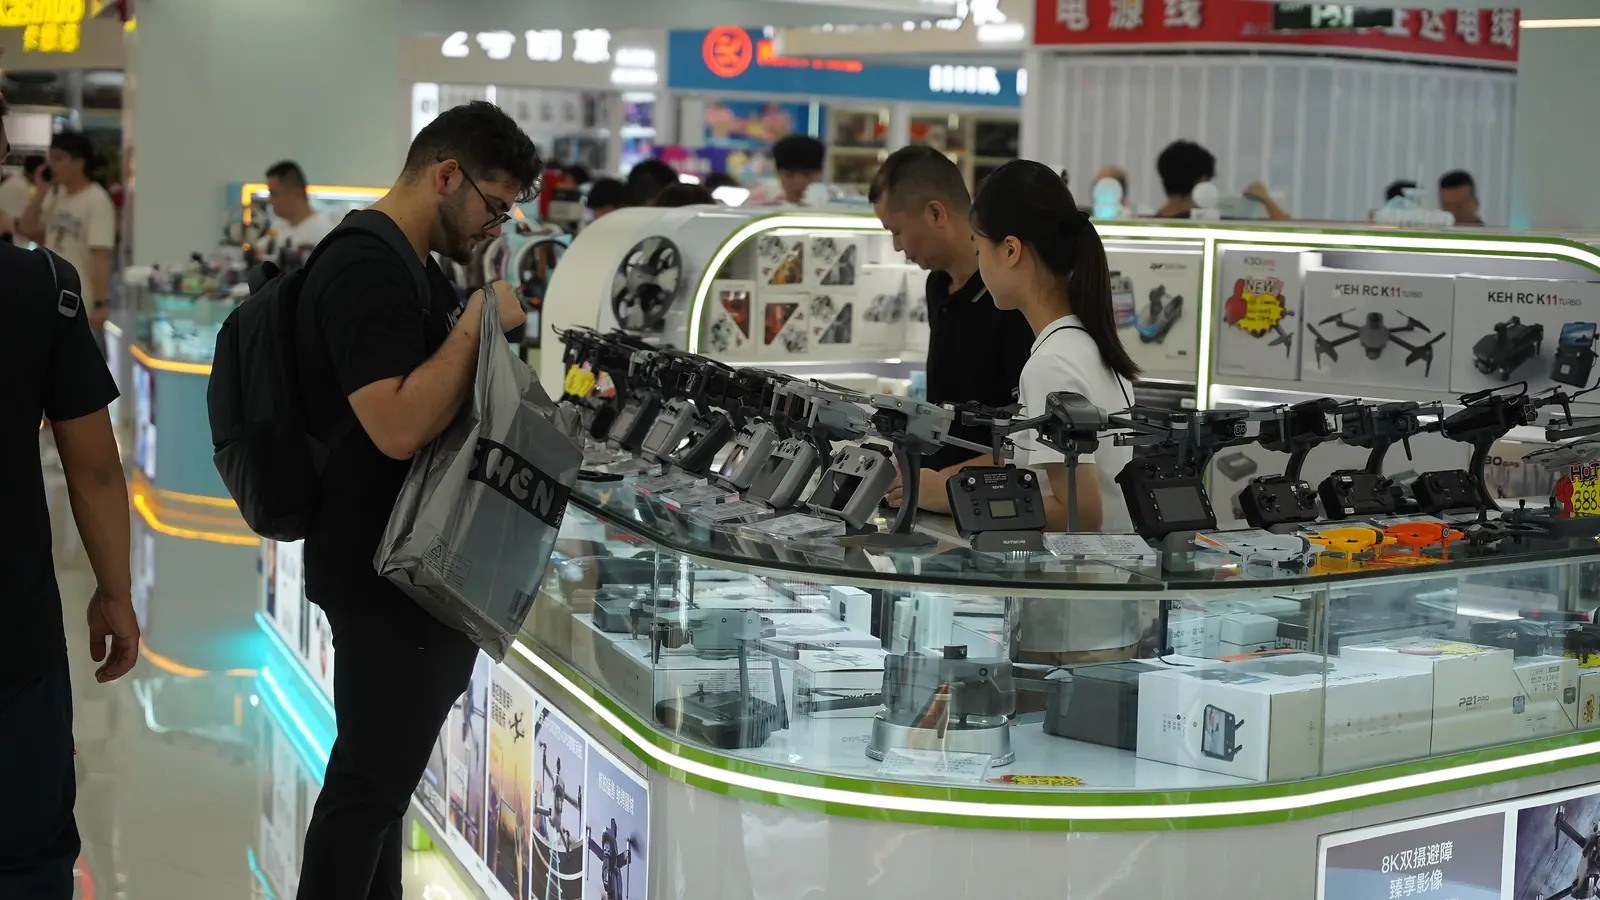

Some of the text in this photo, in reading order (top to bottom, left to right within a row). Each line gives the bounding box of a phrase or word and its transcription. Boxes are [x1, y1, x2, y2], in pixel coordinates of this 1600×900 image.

[1245, 279, 1274, 295] NEW
[1335, 284, 1359, 296] KEH
[1362, 285, 1379, 297] RC
[1381, 285, 1401, 298] K11
[1488, 292, 1513, 304] KEH
[1516, 293, 1534, 305] RC
[1537, 294, 1558, 306] K11
[473, 445, 554, 516] HEN
[1570, 461, 1600, 483] HOT
[1574, 489, 1600, 511] 388
[1458, 695, 1477, 707] P21
[1381, 840, 1453, 874] 8K双摄避障
[1389, 868, 1443, 900] 臻享影像
